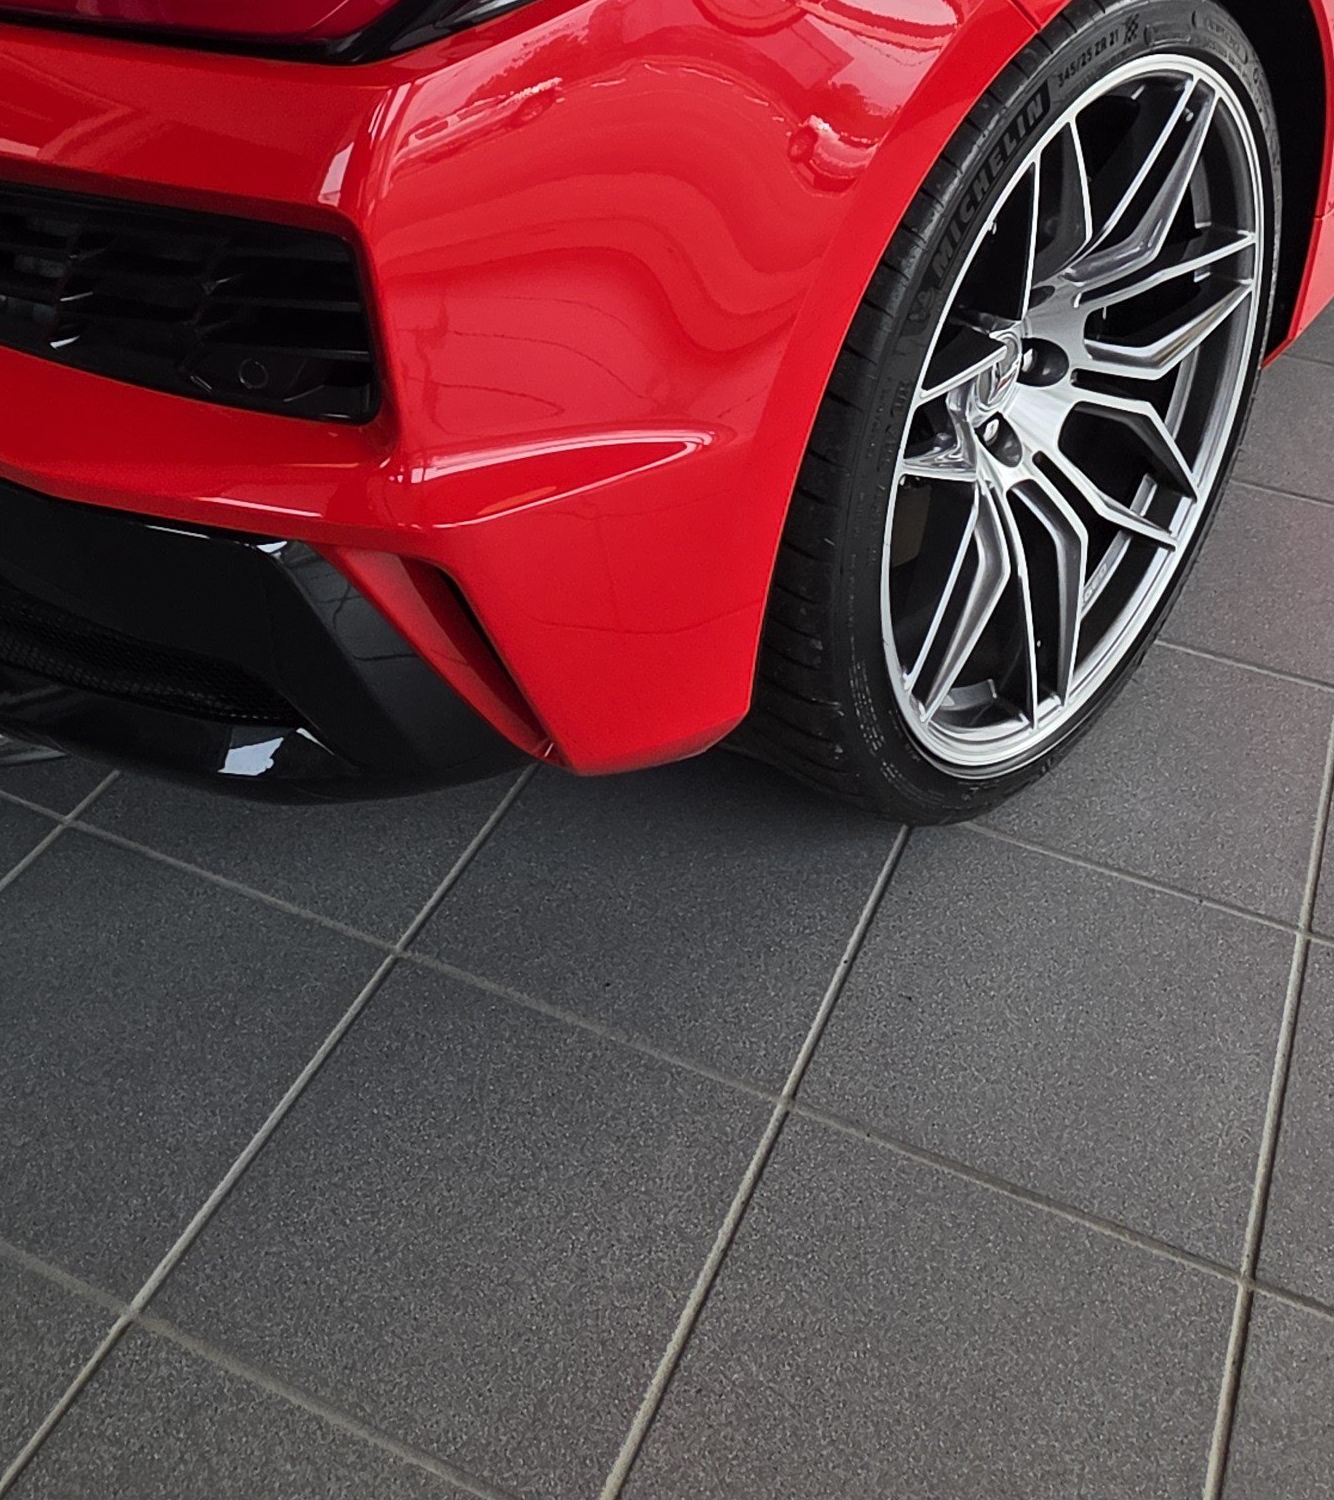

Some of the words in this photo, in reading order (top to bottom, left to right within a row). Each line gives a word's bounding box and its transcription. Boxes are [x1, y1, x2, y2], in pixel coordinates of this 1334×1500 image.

[1054, 47, 1093, 89] 345/25
[1094, 36, 1107, 57] ZR
[931, 90, 1045, 281] MICHELIN
